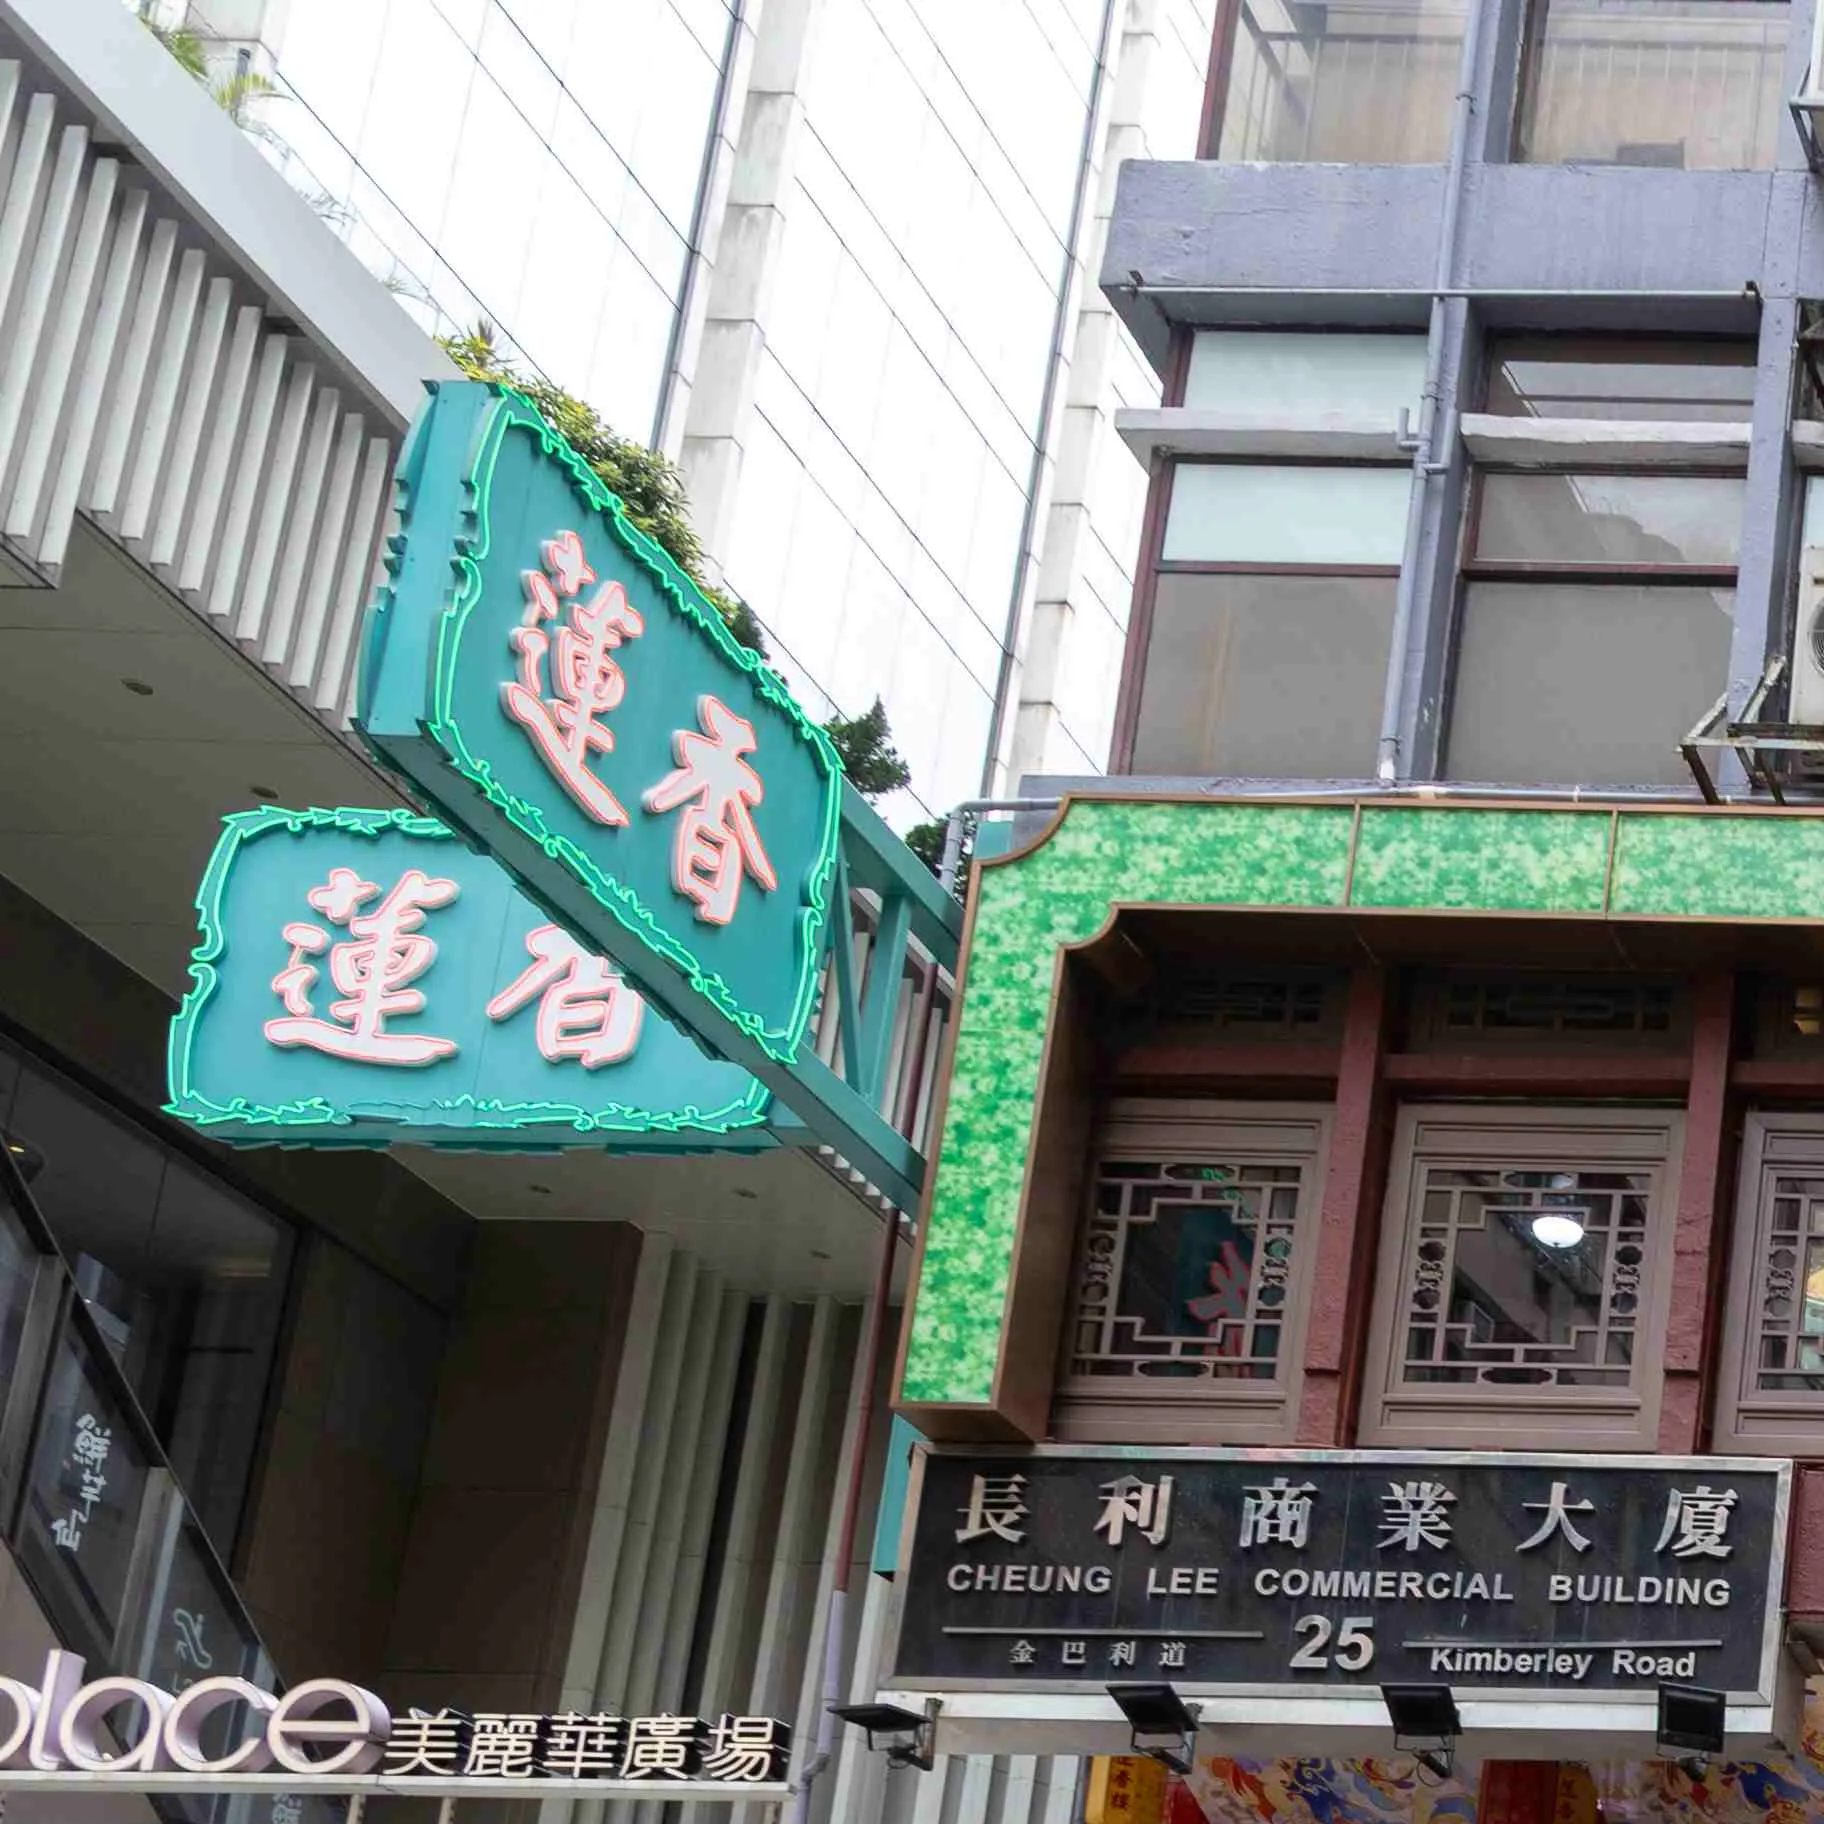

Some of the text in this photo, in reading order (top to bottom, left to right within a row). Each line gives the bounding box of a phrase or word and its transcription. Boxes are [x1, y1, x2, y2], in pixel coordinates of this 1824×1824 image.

[500, 530, 778, 925] 蓮香
[955, 1473, 1740, 1559] 長利商業大廈
[947, 1562, 1731, 1607] CHEUNG LEE COMMERCIAL BUILDING
[1008, 1639, 1187, 1668] 金巴利道
[1289, 1614, 1375, 1671] 25
[1430, 1646, 1696, 1680] Kimberley Road
[384, 1709, 777, 1782] 美麗華廣場
